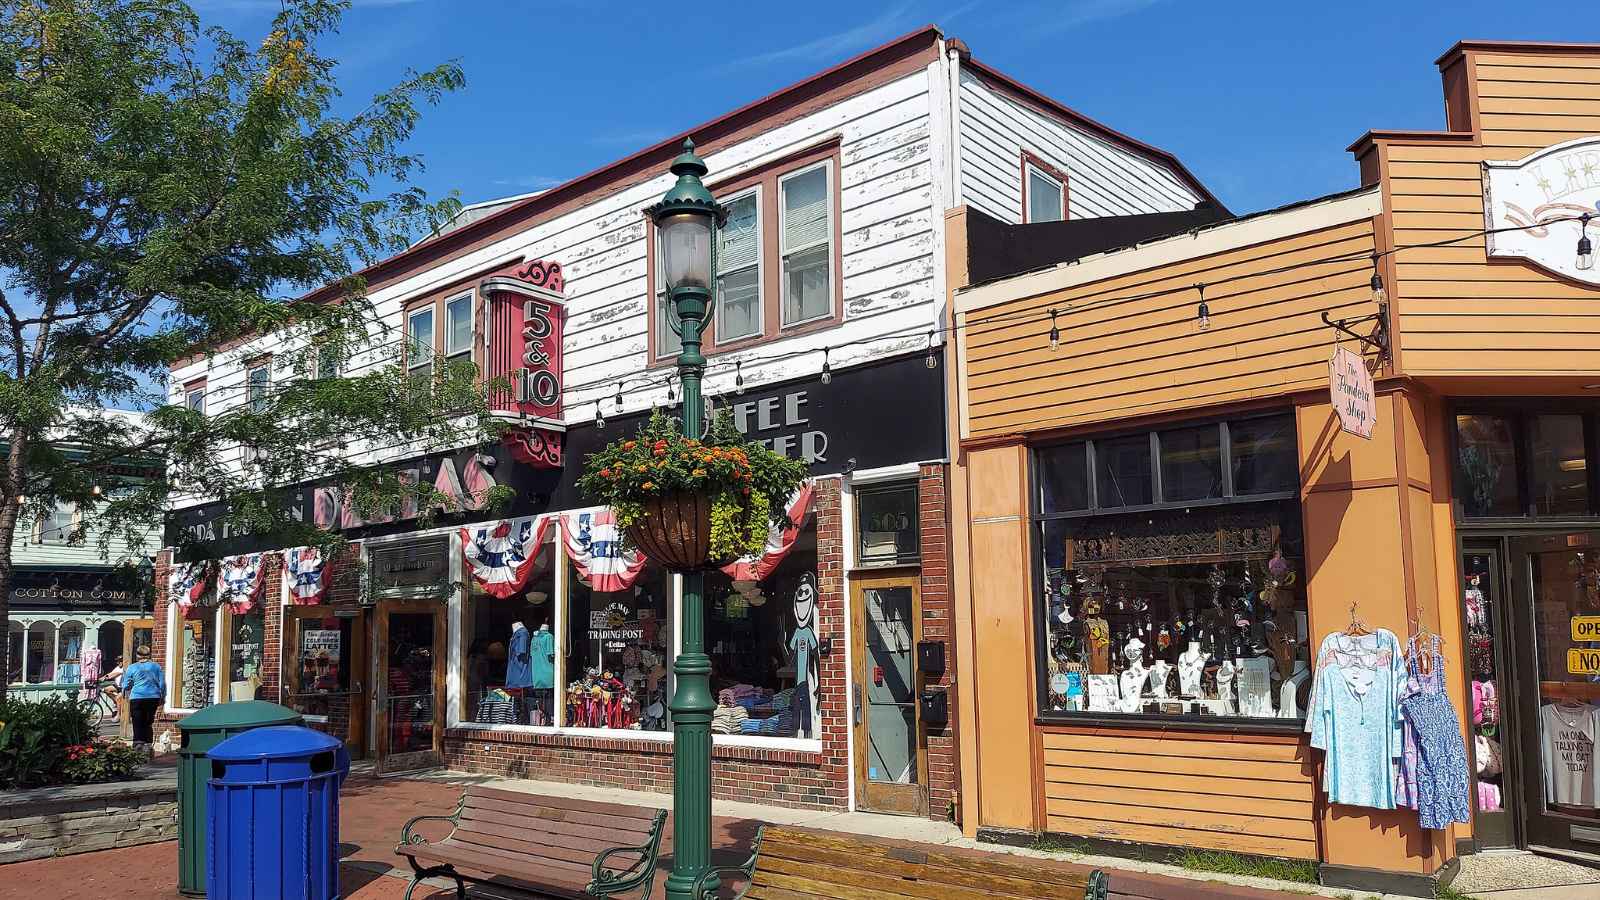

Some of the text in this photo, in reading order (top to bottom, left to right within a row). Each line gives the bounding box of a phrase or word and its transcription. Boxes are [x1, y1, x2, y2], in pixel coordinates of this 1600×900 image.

[522, 301, 552, 339] 5
[523, 341, 551, 365] &
[1347, 362, 1357, 375] The
[516, 367, 560, 406] 10
[1336, 373, 1370, 402] Pandora
[1346, 400, 1366, 427] Shop
[15, 588, 83, 598] COTTON
[588, 629, 644, 640] TRADING POST
[1559, 730, 1569, 740] I'M
[1554, 741, 1583, 751] TALKING
[1562, 753, 1573, 761] MY
[1566, 762, 1587, 772] TODAY
